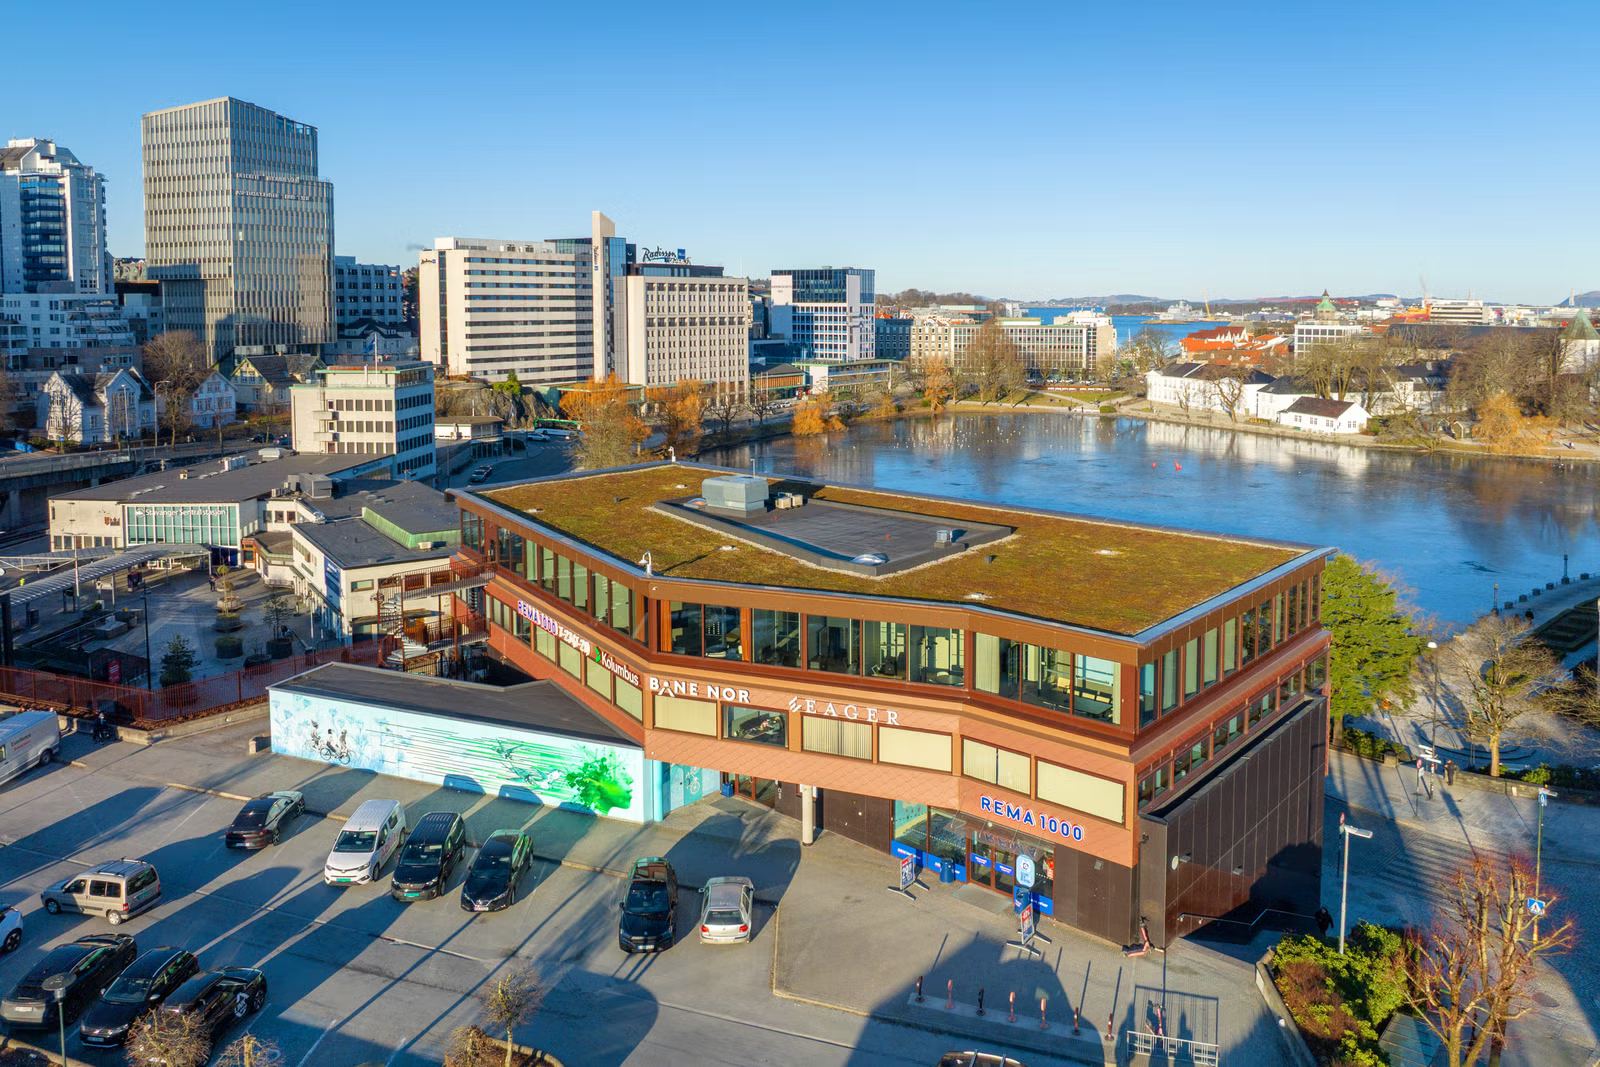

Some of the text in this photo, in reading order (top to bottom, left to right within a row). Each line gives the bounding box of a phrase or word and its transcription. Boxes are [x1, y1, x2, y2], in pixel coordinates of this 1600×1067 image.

[641, 245, 677, 263] Radisson
[517, 599, 558, 636] REMA 1000
[601, 651, 639, 686] Kolumbus
[649, 677, 751, 704] BANE NOR
[804, 698, 900, 725] EAGER
[980, 795, 1085, 842] REMA 1000
